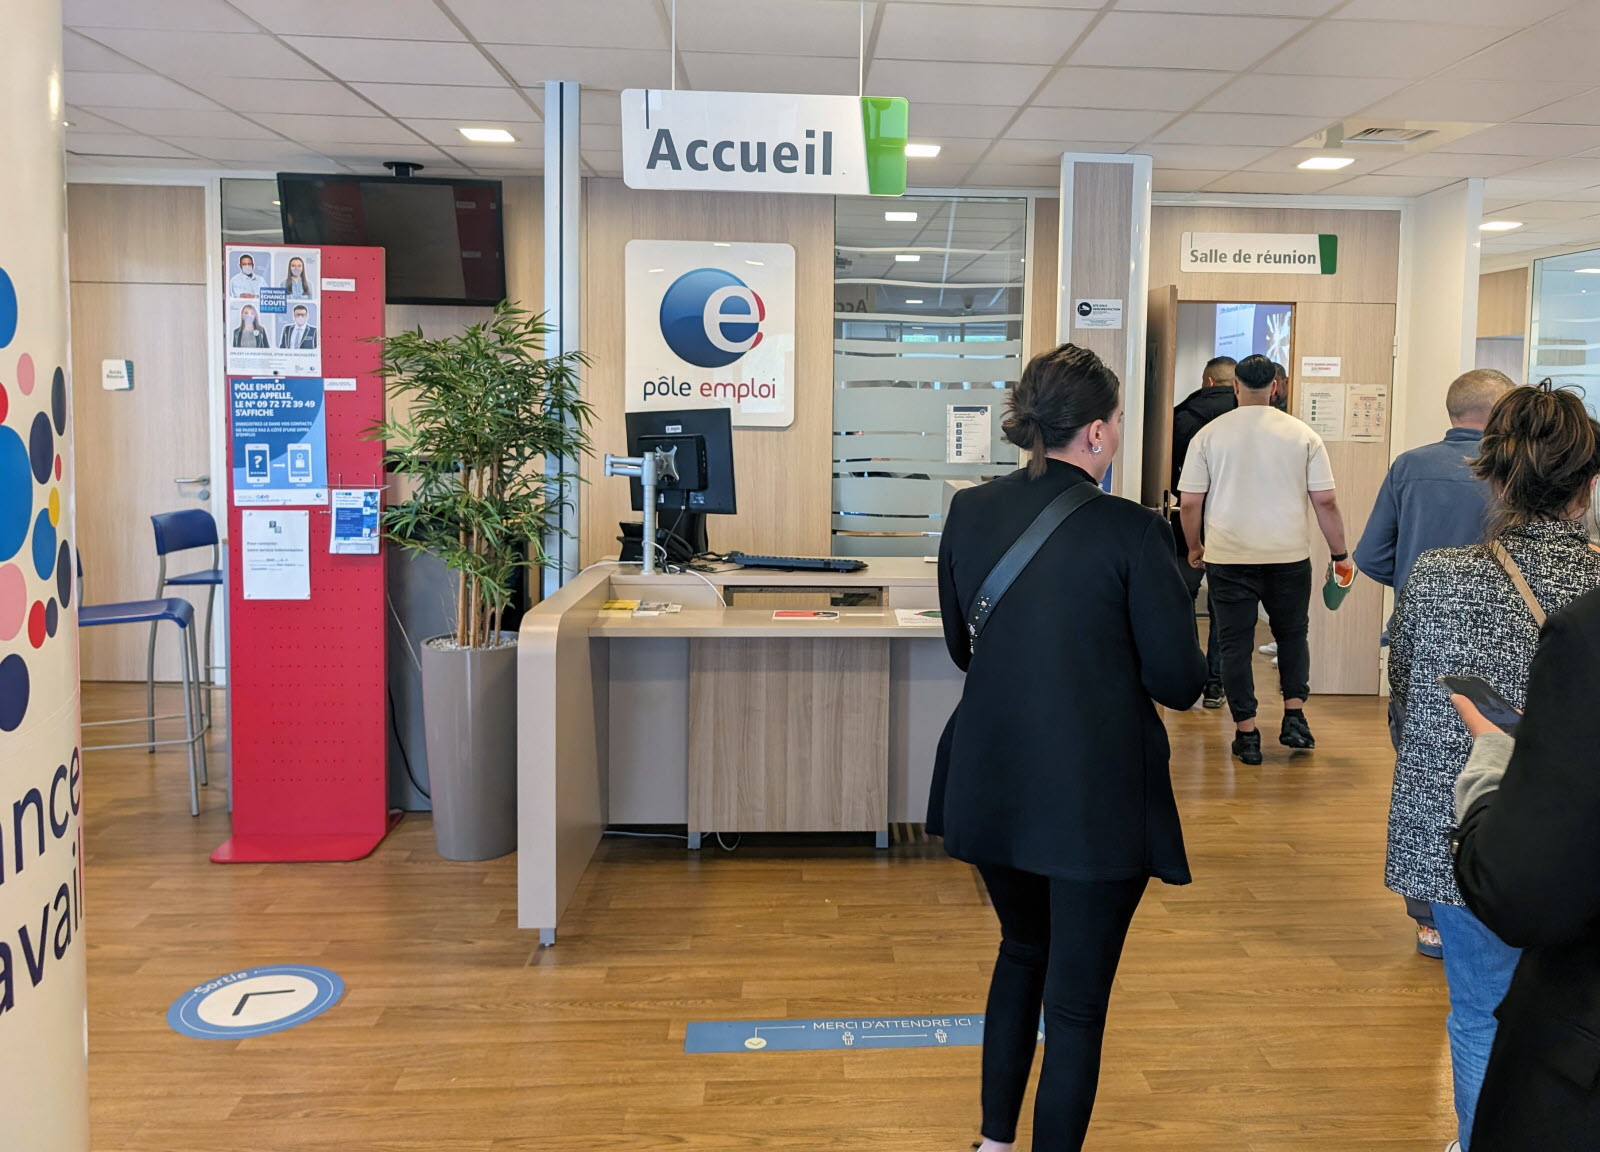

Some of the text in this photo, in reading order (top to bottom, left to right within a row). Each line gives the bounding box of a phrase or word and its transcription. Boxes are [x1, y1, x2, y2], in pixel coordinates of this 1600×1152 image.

[646, 129, 833, 175] Accueil
[1190, 249, 1317, 264] Salle de réunion
[234, 382, 285, 391] PÔLE EMPLOI
[643, 376, 776, 404] pôle emploi
[235, 392, 294, 401] VOUS APPELLE,
[235, 400, 316, 408] LE N° 09 72 72 39 49
[235, 409, 275, 417] S'AFFICHE
[193, 971, 248, 994] Sortie
[813, 1018, 972, 1030] MERCI D'ATTENDRE ICI
